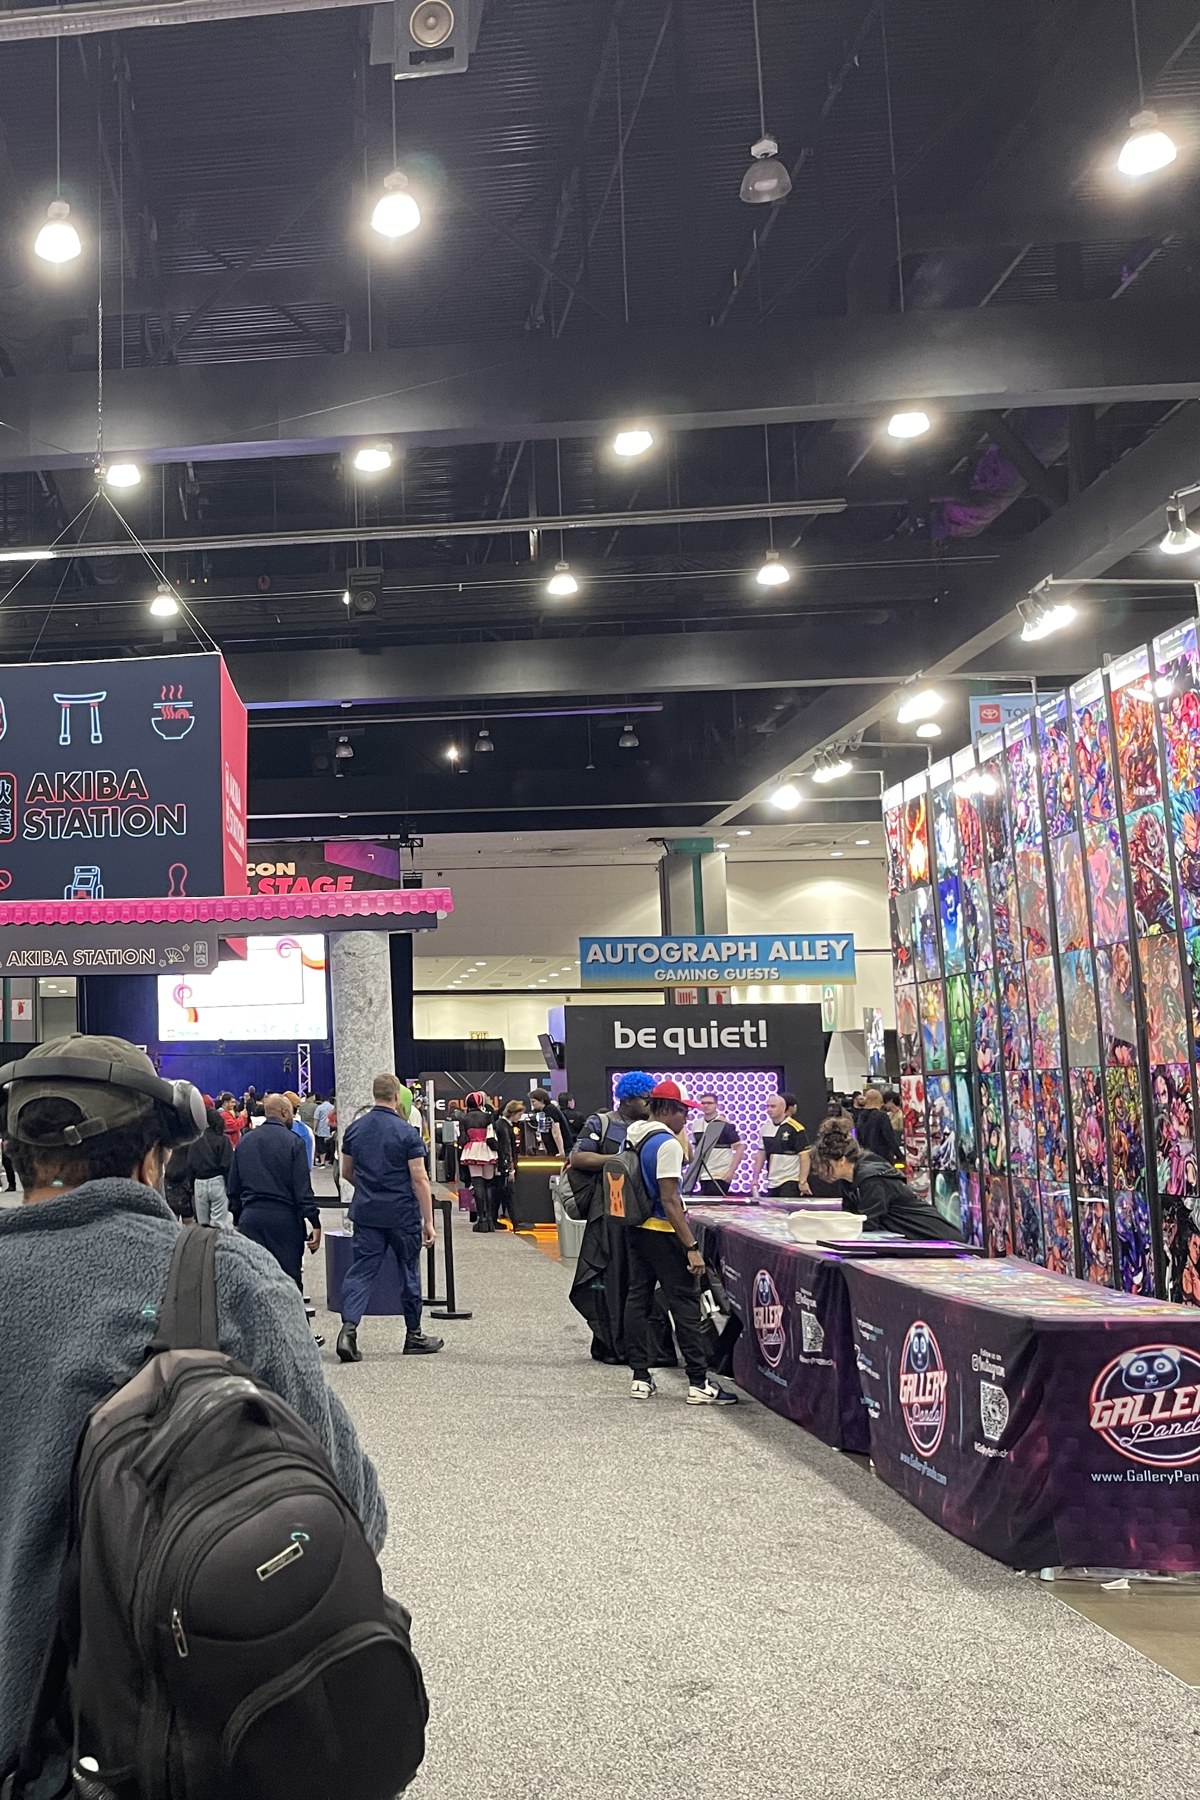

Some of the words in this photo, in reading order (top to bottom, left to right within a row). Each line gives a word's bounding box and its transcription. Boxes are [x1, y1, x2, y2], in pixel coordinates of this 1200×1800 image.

[25, 769, 149, 803] AKIBA
[23, 804, 187, 840] STATION
[258, 876, 355, 895] STAGE
[6, 950, 68, 966] AKIBA
[73, 949, 156, 965] STATION
[585, 941, 757, 964] AUTOGRAPH
[768, 940, 849, 961] ALLEY
[654, 969, 719, 981] GAMING
[724, 967, 779, 980] GUESTS
[614, 1021, 656, 1048] be
[663, 1020, 768, 1054] quiet!
[900, 1370, 948, 1404] GALLERY
